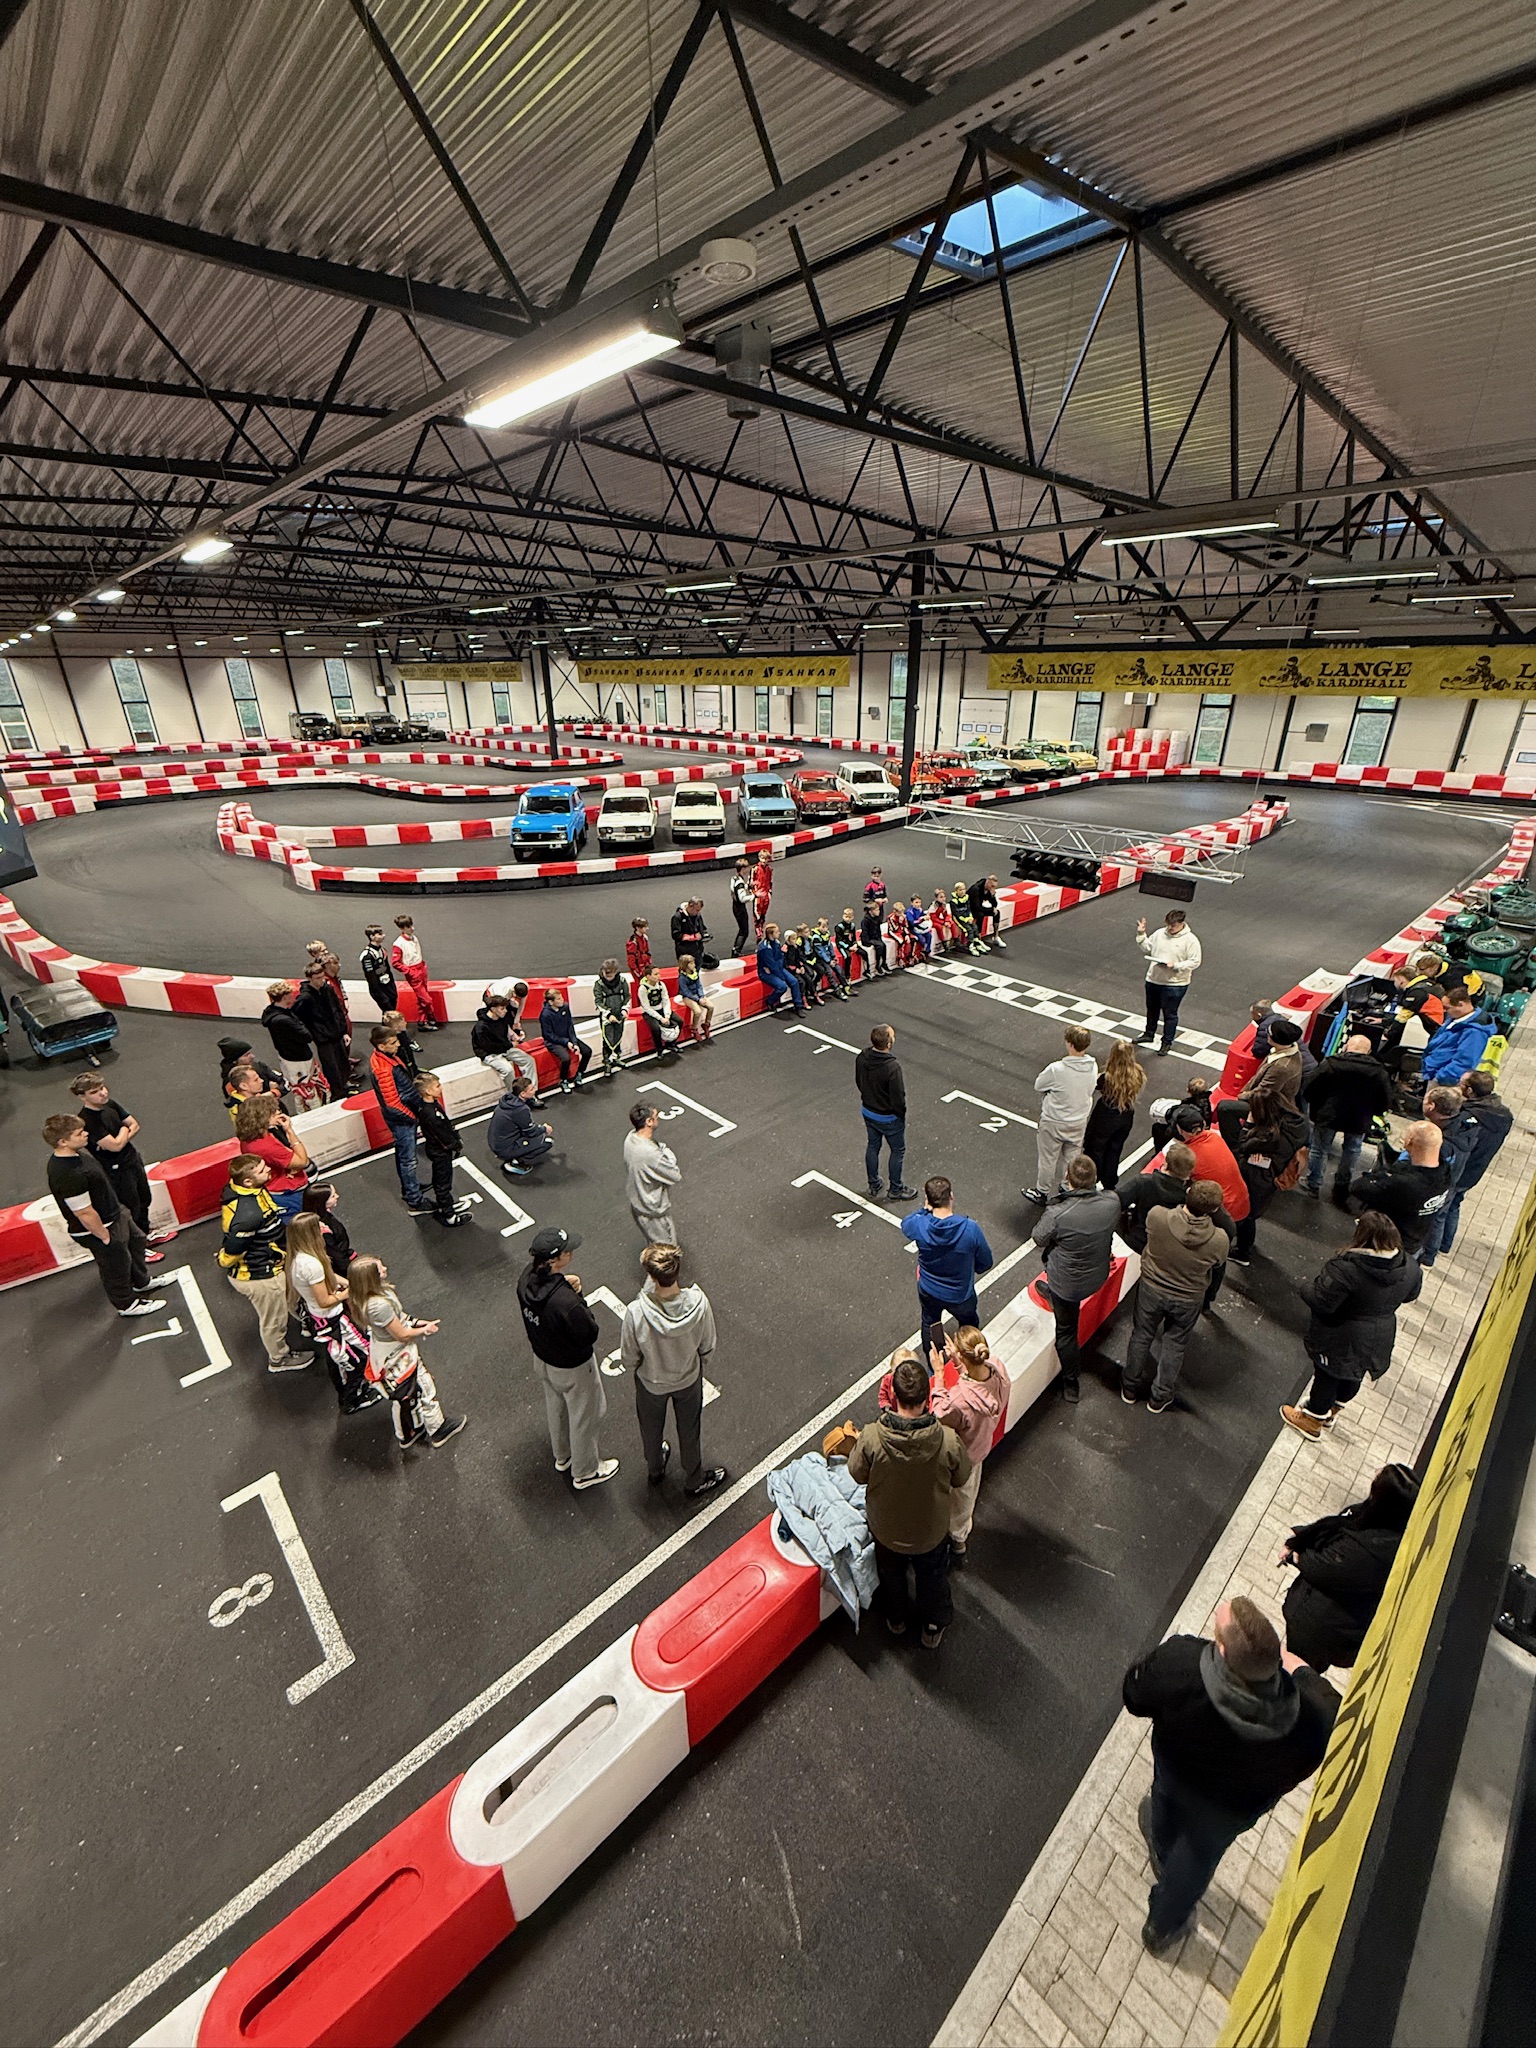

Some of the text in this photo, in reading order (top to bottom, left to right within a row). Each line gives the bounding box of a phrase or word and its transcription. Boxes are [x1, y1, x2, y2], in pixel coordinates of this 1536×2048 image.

[776, 668, 837, 677] SAHKAR
[1037, 662, 1096, 675] LANGE
[1161, 662, 1235, 676] LANGE
[1318, 661, 1413, 677] LANGE
[1035, 675, 1094, 684] KARDIHALL
[1159, 677, 1231, 686] KARDIHALL
[1316, 677, 1408, 689] KARDIHALL
[812, 1044, 832, 1054] 1
[658, 1106, 685, 1120] 3
[979, 1116, 1008, 1133] 2
[831, 1210, 863, 1229] 4
[130, 1316, 183, 1346] 7
[208, 1572, 274, 1627] 8
